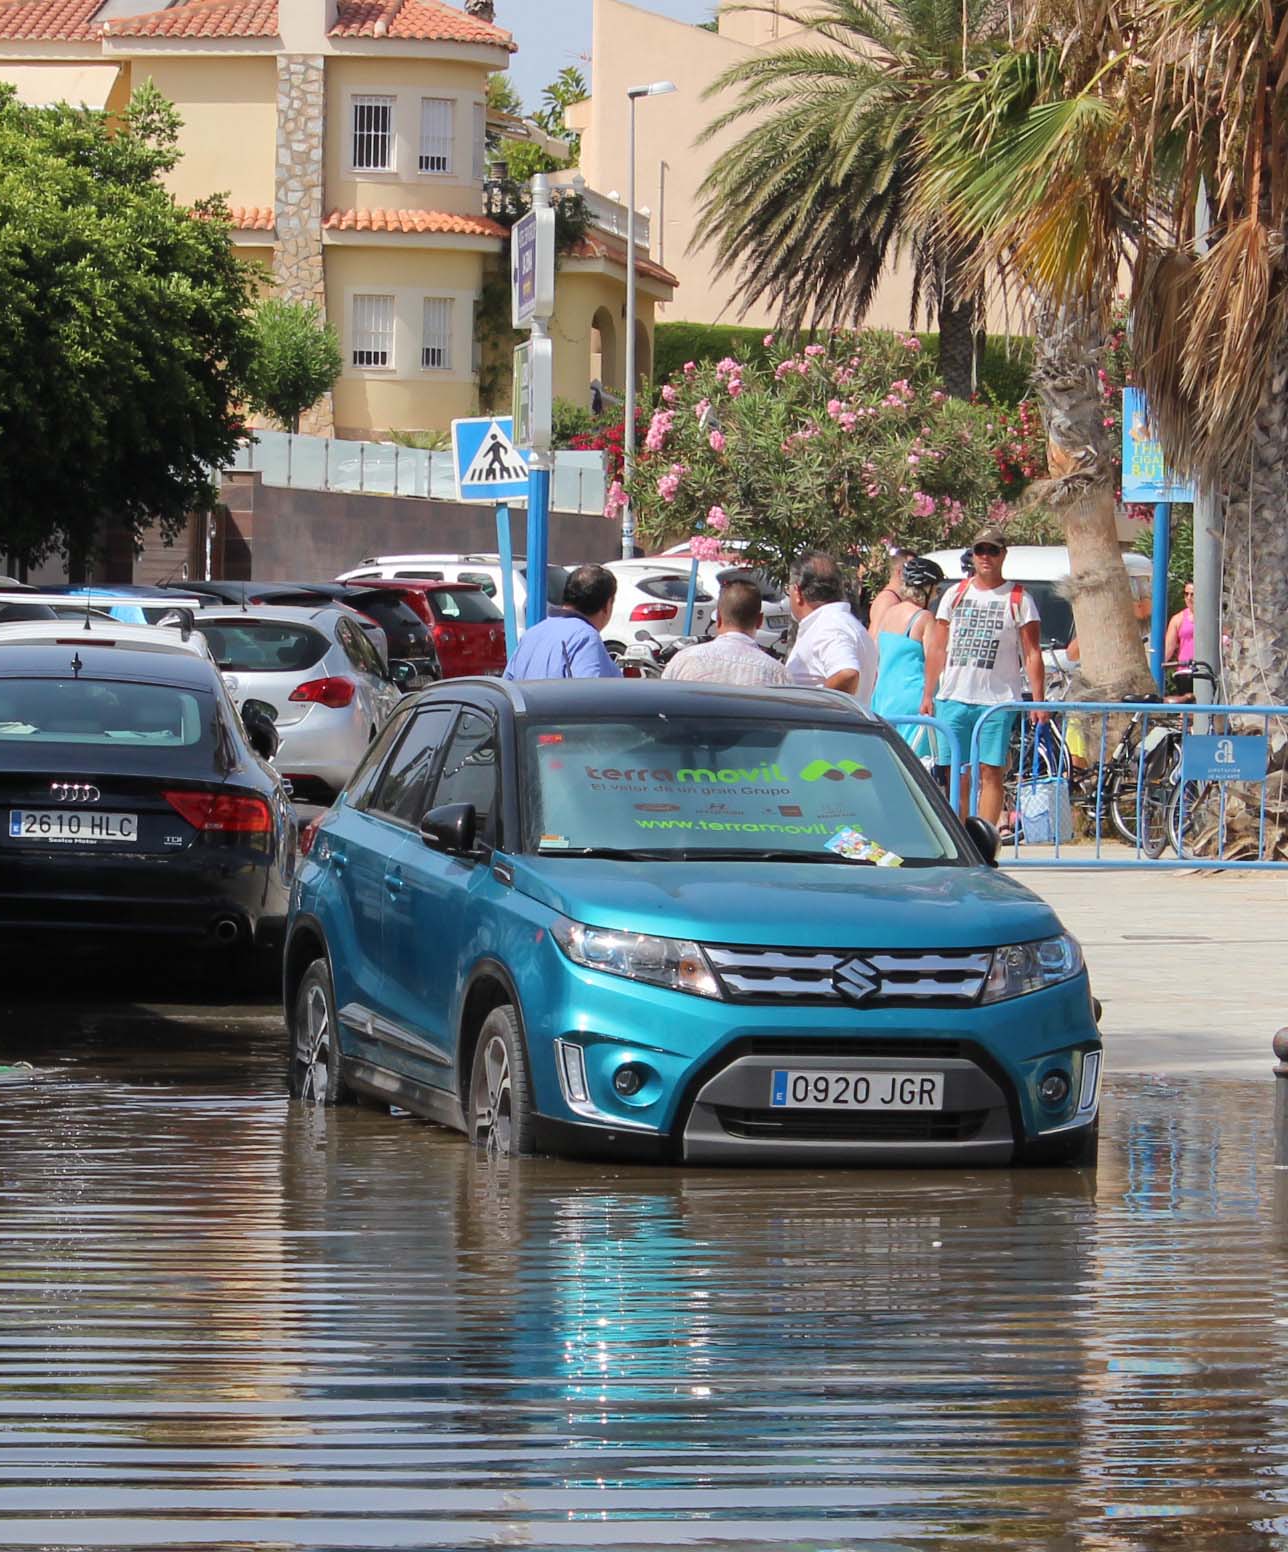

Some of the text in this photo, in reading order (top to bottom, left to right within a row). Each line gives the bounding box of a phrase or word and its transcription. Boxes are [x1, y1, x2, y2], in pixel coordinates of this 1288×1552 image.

[584, 762, 789, 783] terramovil
[741, 787, 791, 796] Grupo
[25, 814, 80, 835] 2610
[91, 816, 132, 837] HLC
[793, 1075, 870, 1105] 0920
[880, 1077, 936, 1106] JGR
